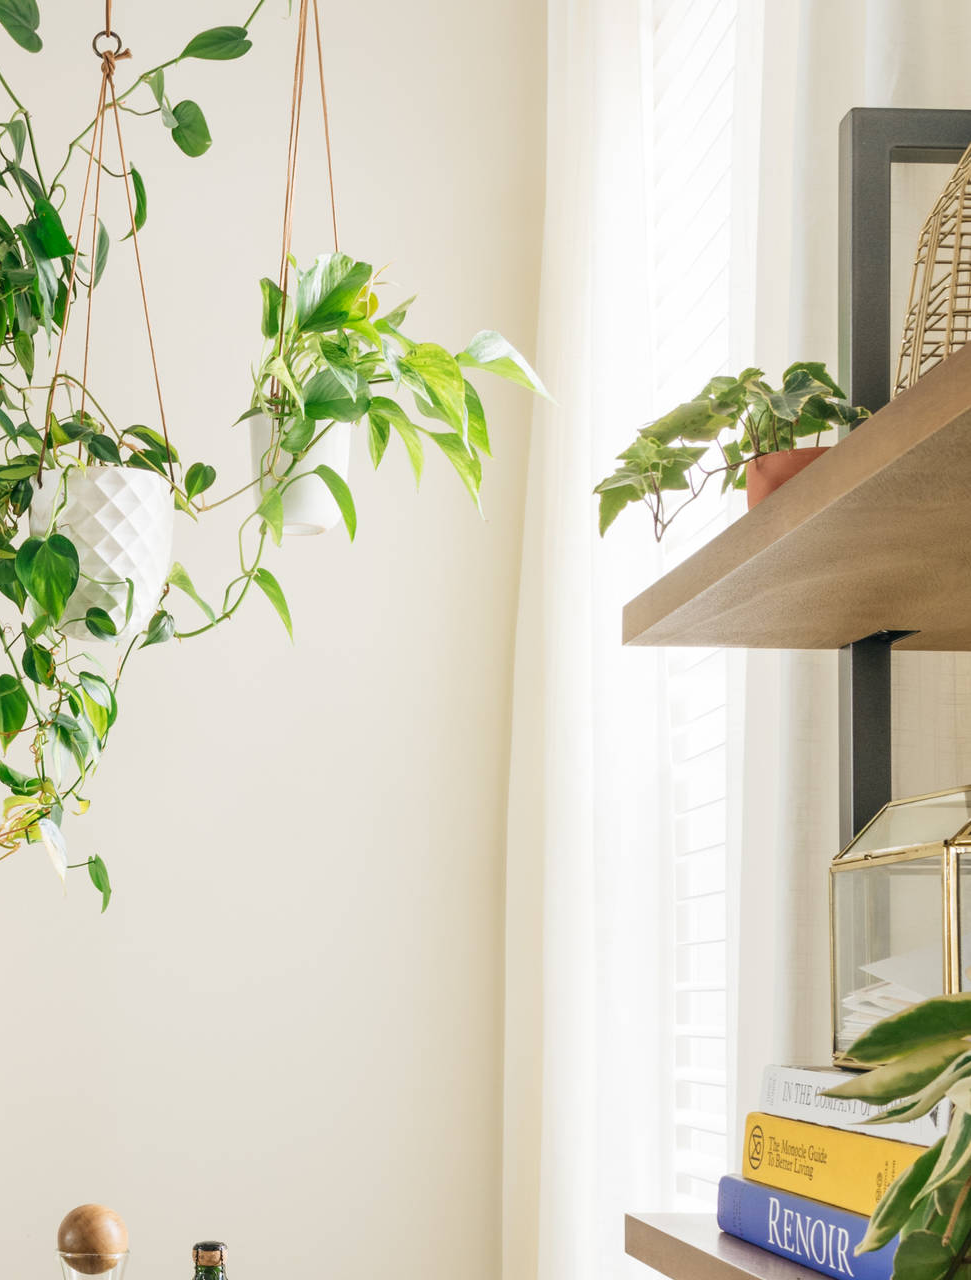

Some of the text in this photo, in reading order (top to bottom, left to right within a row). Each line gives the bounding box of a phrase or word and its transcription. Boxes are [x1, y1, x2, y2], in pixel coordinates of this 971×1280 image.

[794, 1082, 813, 1106] THE
[768, 1135, 828, 1164] The Monocle Guide
[767, 1151, 814, 1181] To Better Living
[767, 1196, 855, 1278] RENOIR
